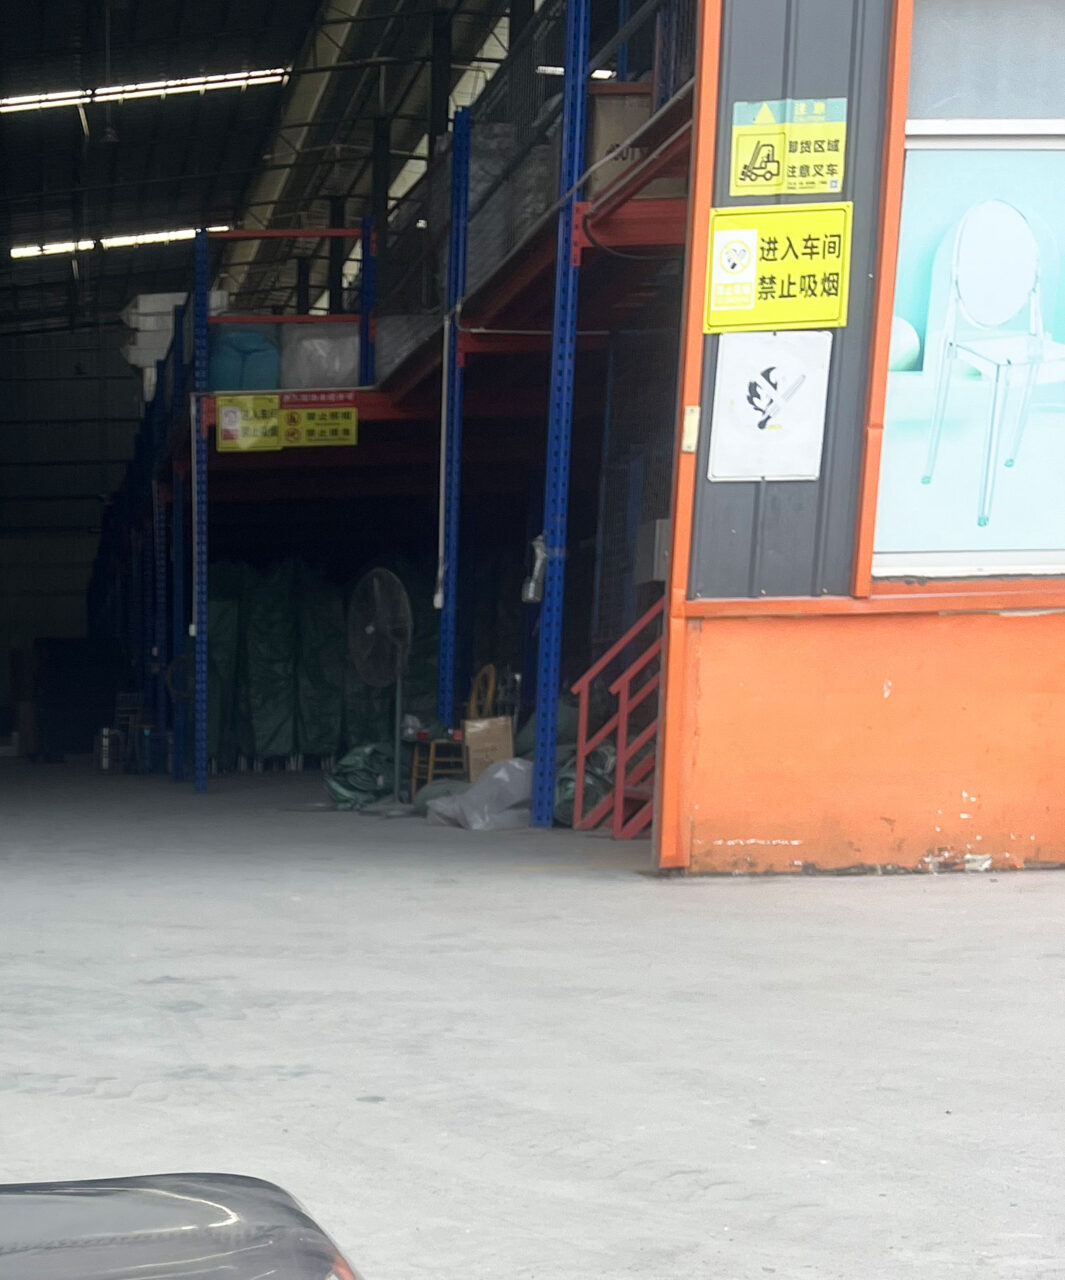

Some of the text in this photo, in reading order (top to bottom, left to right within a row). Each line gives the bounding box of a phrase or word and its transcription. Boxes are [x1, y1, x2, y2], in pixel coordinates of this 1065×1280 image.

[786, 163, 838, 178] 注意叉车
[759, 234, 841, 262] 进入车间
[757, 272, 840, 300] 禁止吸烟
